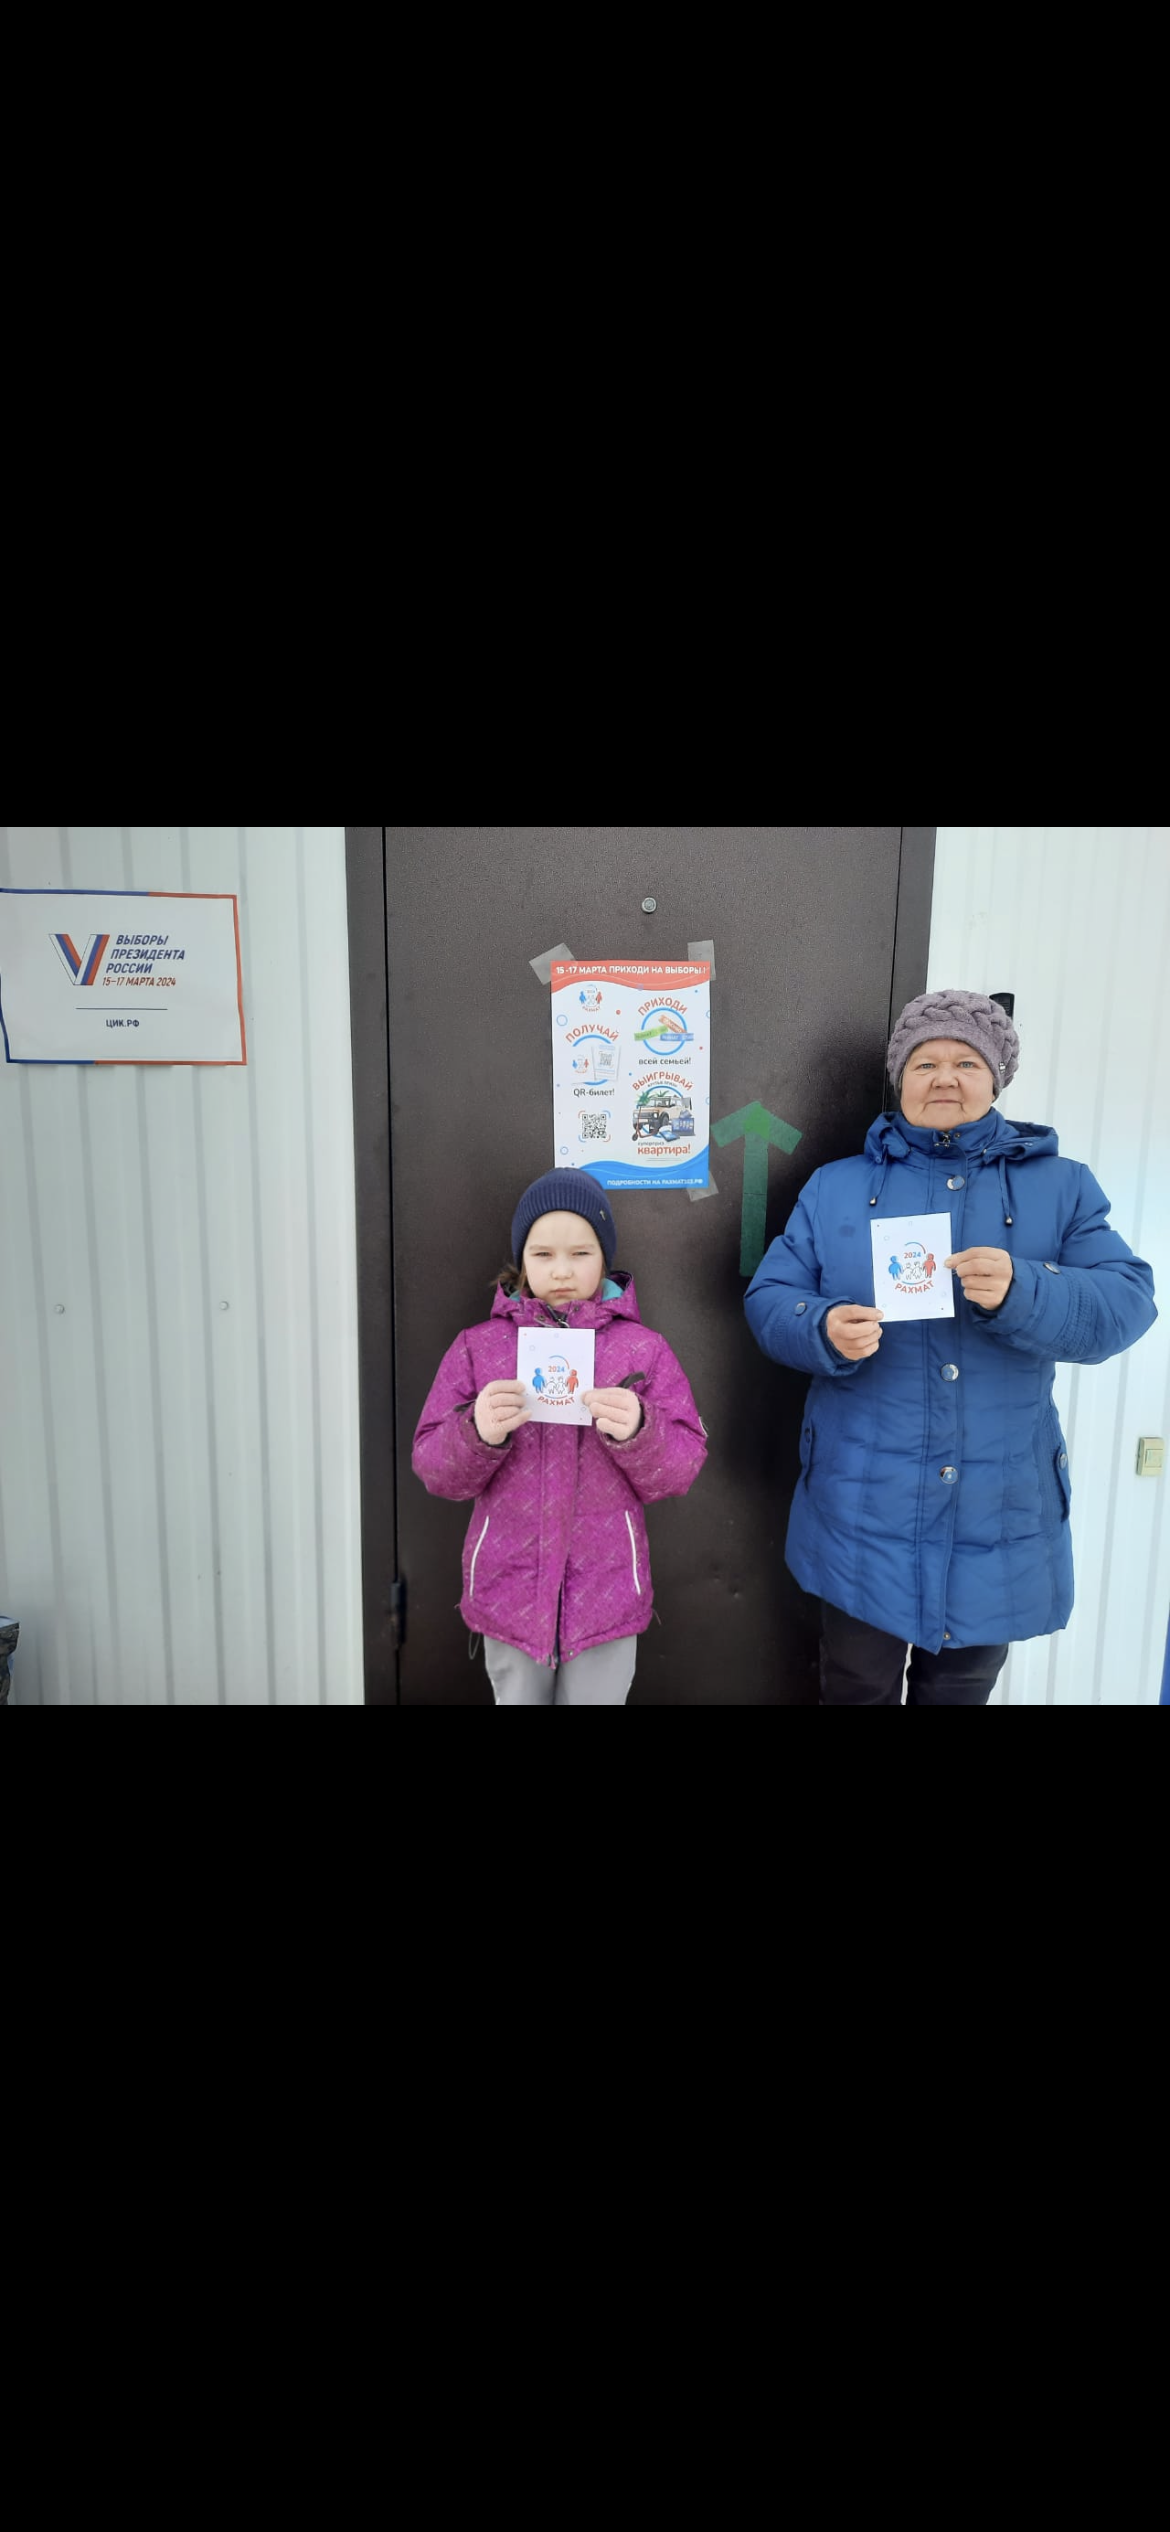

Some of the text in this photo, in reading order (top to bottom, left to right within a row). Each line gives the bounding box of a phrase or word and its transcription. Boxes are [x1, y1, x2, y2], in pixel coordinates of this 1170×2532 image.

[116, 935, 169, 945] ВЫБОРЫ
[111, 949, 185, 960] ПРЕЗИДЕНТА
[106, 963, 153, 974] РОССИИ
[579, 966, 607, 974] МАРТА
[609, 965, 650, 975] ПРИХОДИ
[652, 966, 663, 974] НА
[126, 977, 155, 987] МАРТА
[156, 977, 176, 987] 2024
[637, 997, 688, 1016] ПРИХОДИ
[106, 1019, 140, 1028] ЦИК.РФ
[565, 1024, 620, 1043] ПОЛУЧАЙ
[638, 1057, 658, 1065] всей
[632, 1071, 694, 1091] ВЫИГРЫВАЙ
[573, 1088, 615, 1096] QR-билет!
[637, 1144, 691, 1156] квартира!
[607, 1179, 652, 1187] ПОДРОБНОСТИ
[895, 1280, 934, 1293] РАХМАТ
[548, 1365, 565, 1373] 2024
[537, 1395, 575, 1406] РАХМАТ
